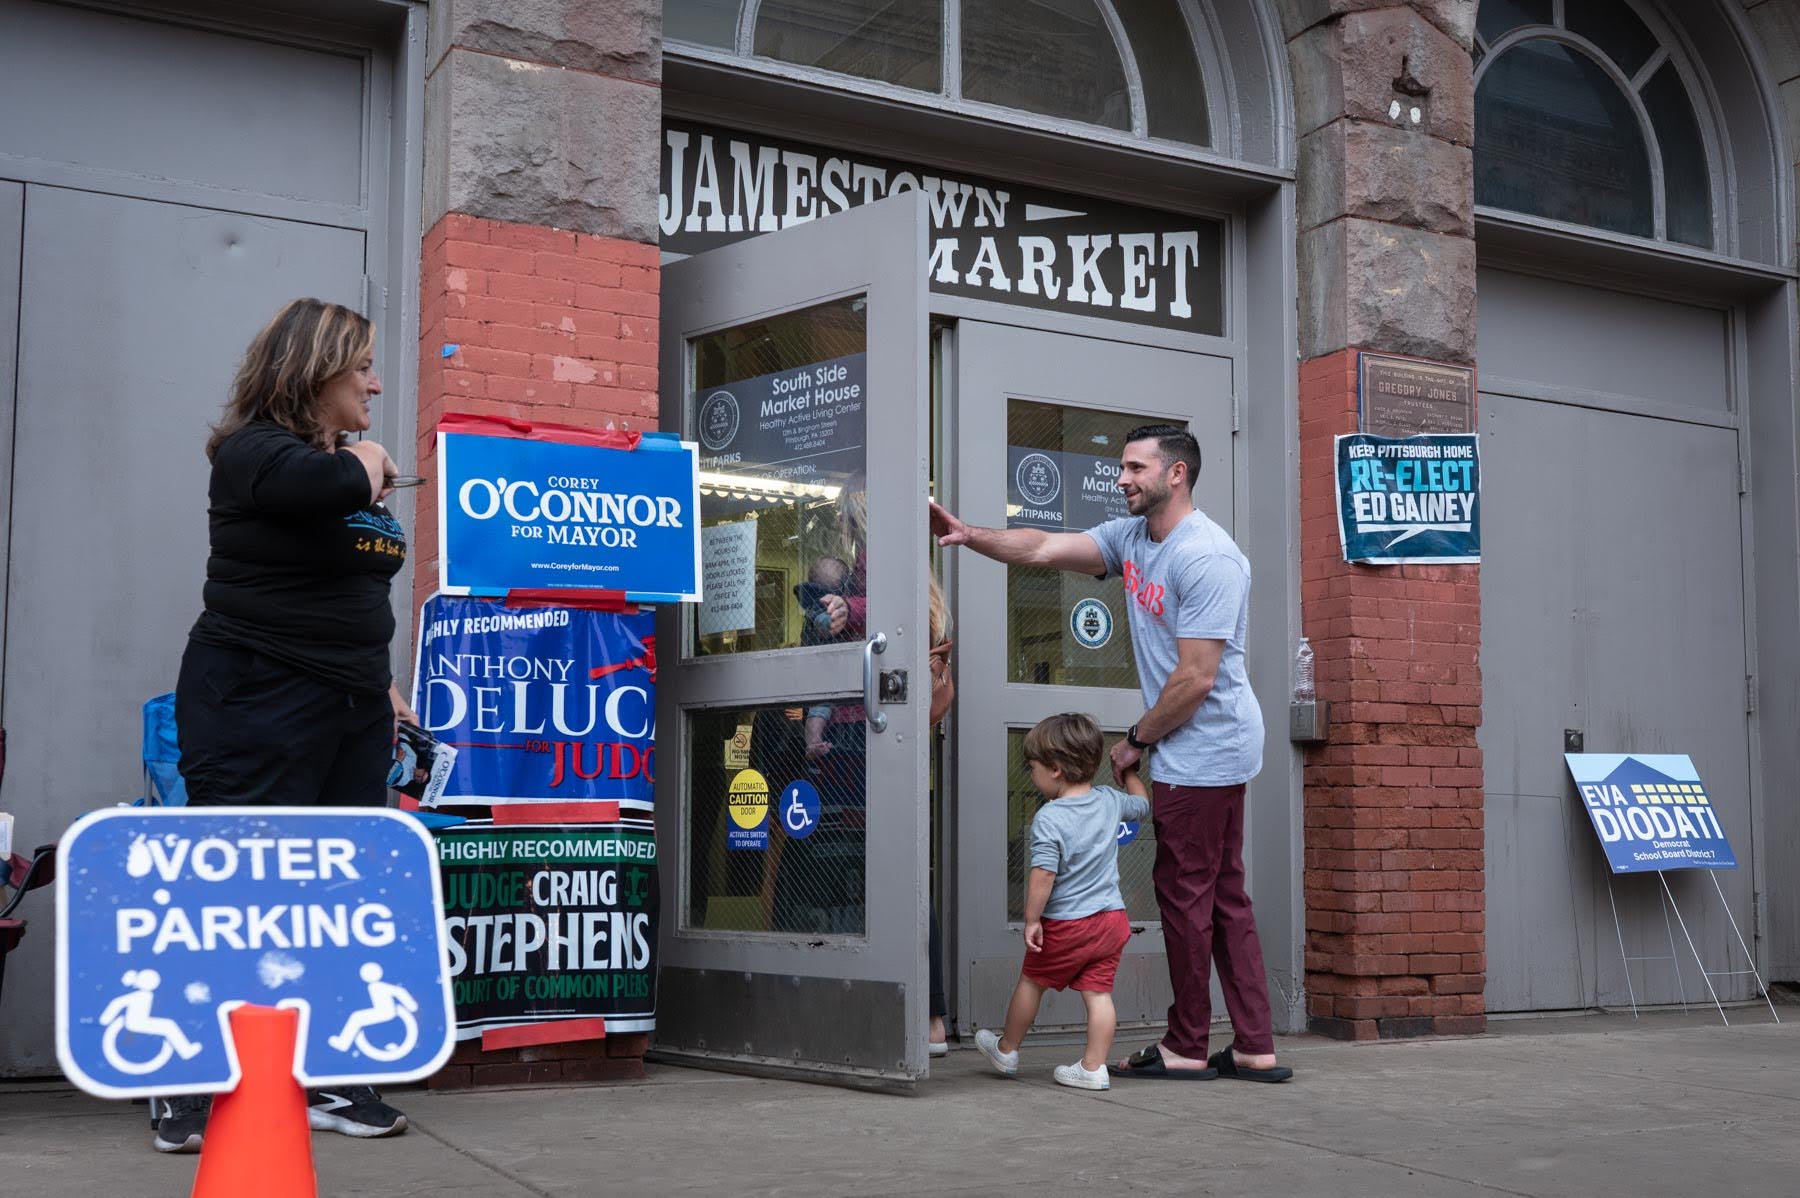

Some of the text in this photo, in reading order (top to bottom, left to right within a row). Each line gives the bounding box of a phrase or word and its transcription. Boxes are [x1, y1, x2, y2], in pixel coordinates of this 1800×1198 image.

[772, 364, 848, 395] South Side
[1378, 381, 1457, 402] GREGORY JONES
[760, 383, 861, 418] Market House
[759, 402, 861, 431] Healthy Active Living Center
[1348, 444, 1472, 459] KEEP PITTSBURGH HOME
[548, 476, 599, 490] COREY
[773, 464, 817, 480] OPERATION:
[1349, 459, 1474, 493] RE-ELECT
[459, 477, 683, 529] O'CONNOR
[1081, 493, 1108, 504] Healthy
[1353, 492, 1475, 522] ED GAINEY
[511, 524, 638, 549] FOR MAYOR
[531, 561, 620, 573] www.CoreyforMayor.com
[464, 610, 569, 635] RECOMMENDED
[526, 740, 551, 753] FOR
[733, 782, 765, 791] AUTOMATIC
[1581, 784, 1628, 807] EVA
[729, 793, 768, 805] CAUTION
[740, 807, 757, 816] DOOR
[1591, 806, 1724, 842] DIODATI
[512, 839, 656, 859] RECOMMENDED
[1633, 849, 1716, 861] School Board District 7
[1653, 840, 1691, 849] Democrat
[148, 837, 361, 882] VOTER
[444, 869, 617, 910] JUDGE CRAIG
[116, 902, 396, 955] PARKING
[444, 912, 650, 977] STEPHENS
[496, 976, 520, 1001] OF
[524, 975, 609, 1000] COMMON
[612, 973, 649, 998] PLEAS
